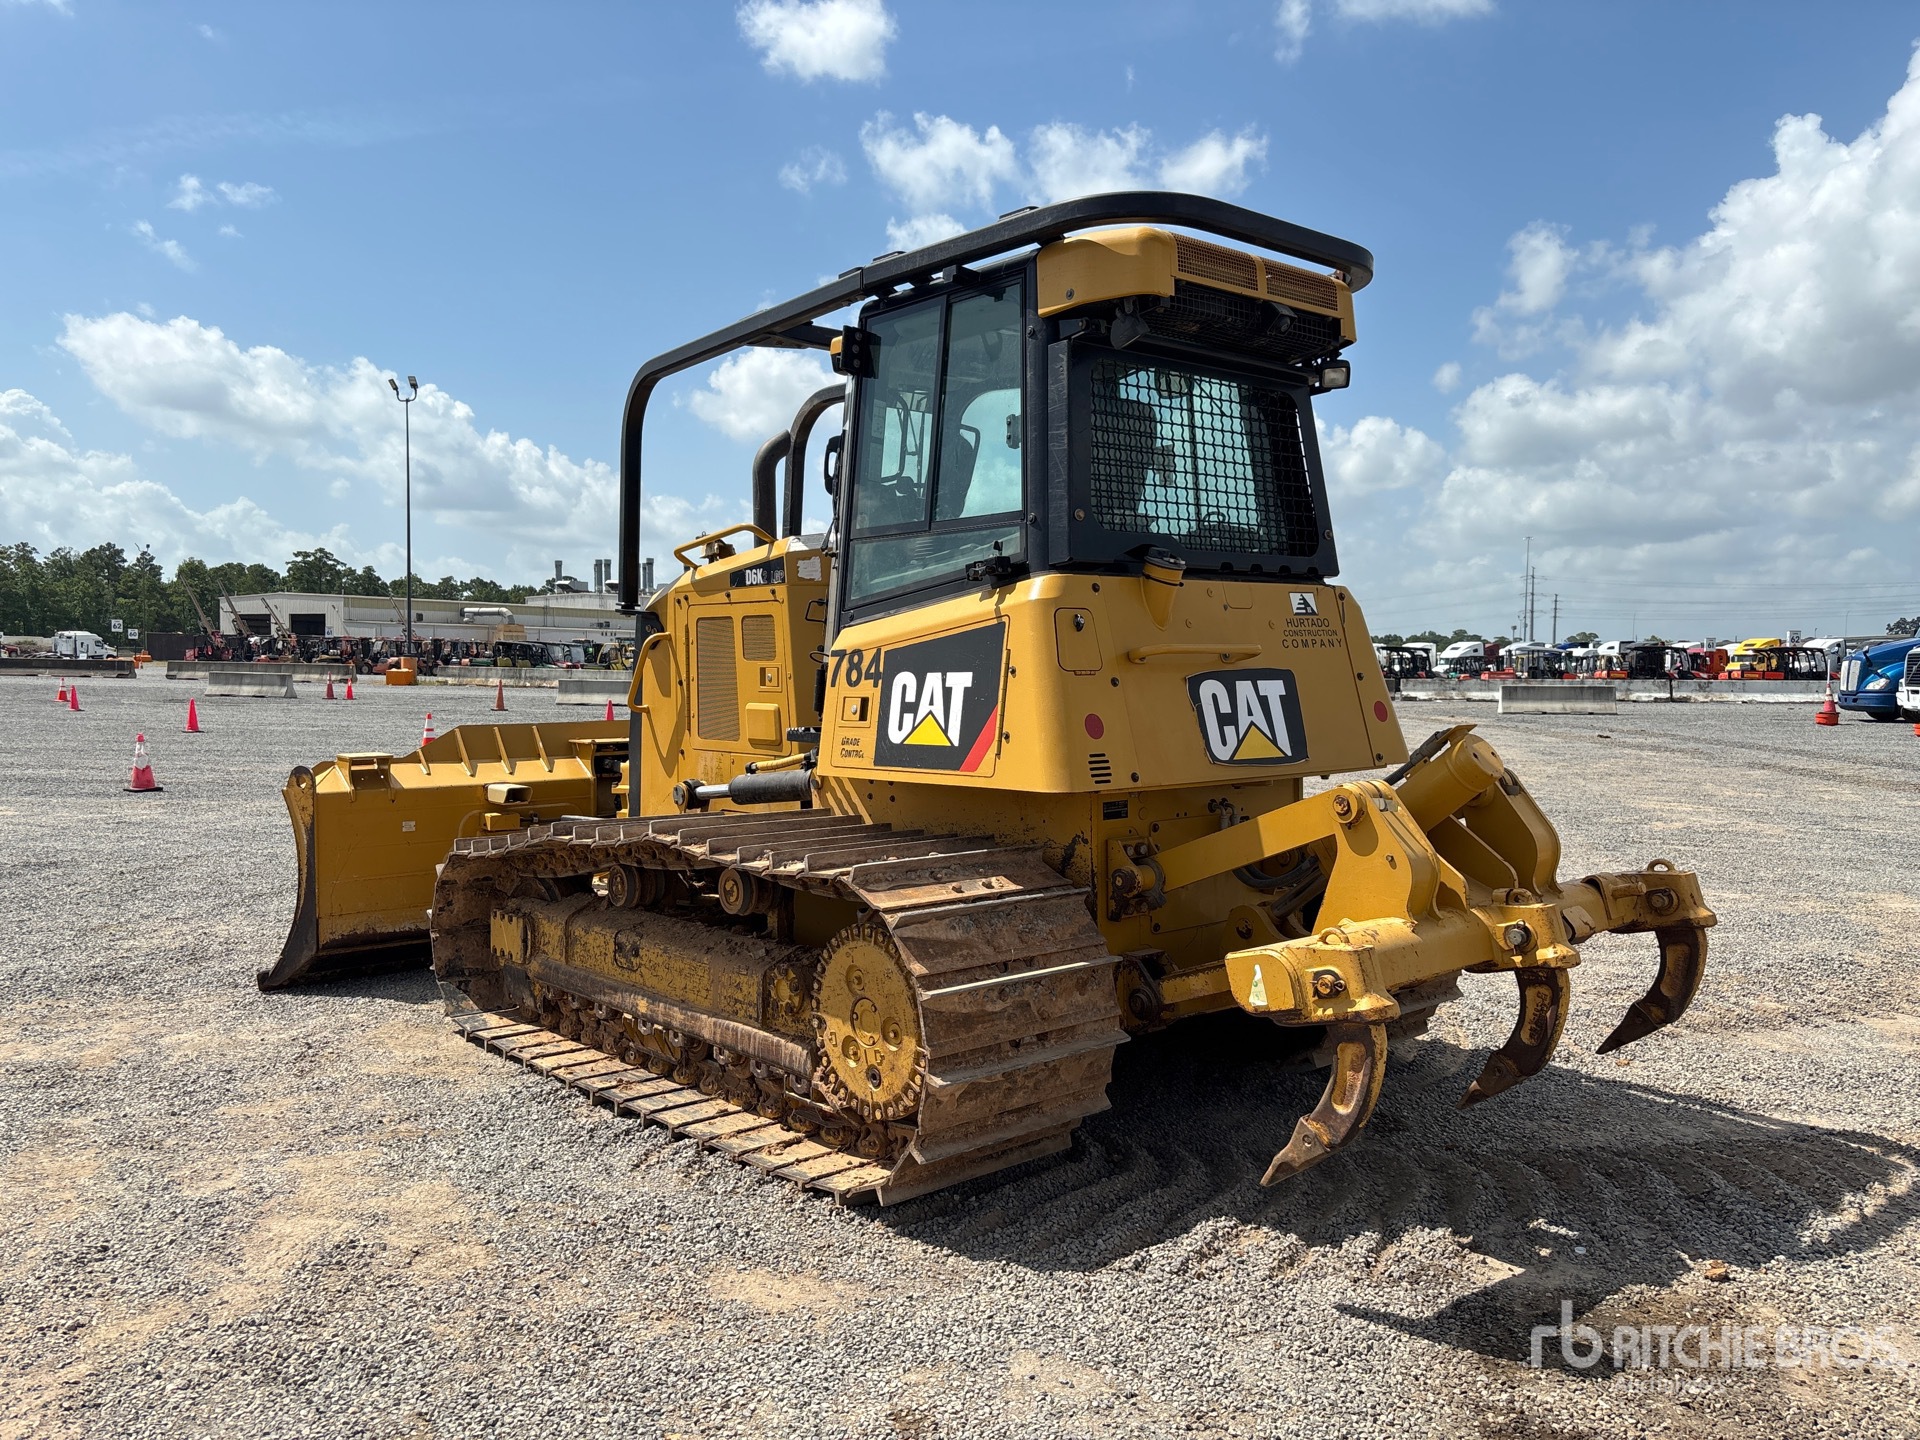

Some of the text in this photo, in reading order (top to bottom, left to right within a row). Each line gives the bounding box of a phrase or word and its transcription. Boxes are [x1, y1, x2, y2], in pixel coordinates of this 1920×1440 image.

[1283, 629, 1338, 637] CONSTRUCTION
[1285, 618, 1330, 628] HURTADO
[1282, 638, 1342, 648] COMPANY
[830, 648, 882, 688] 784
[887, 671, 973, 747] CAT
[1199, 679, 1292, 760] CAT
